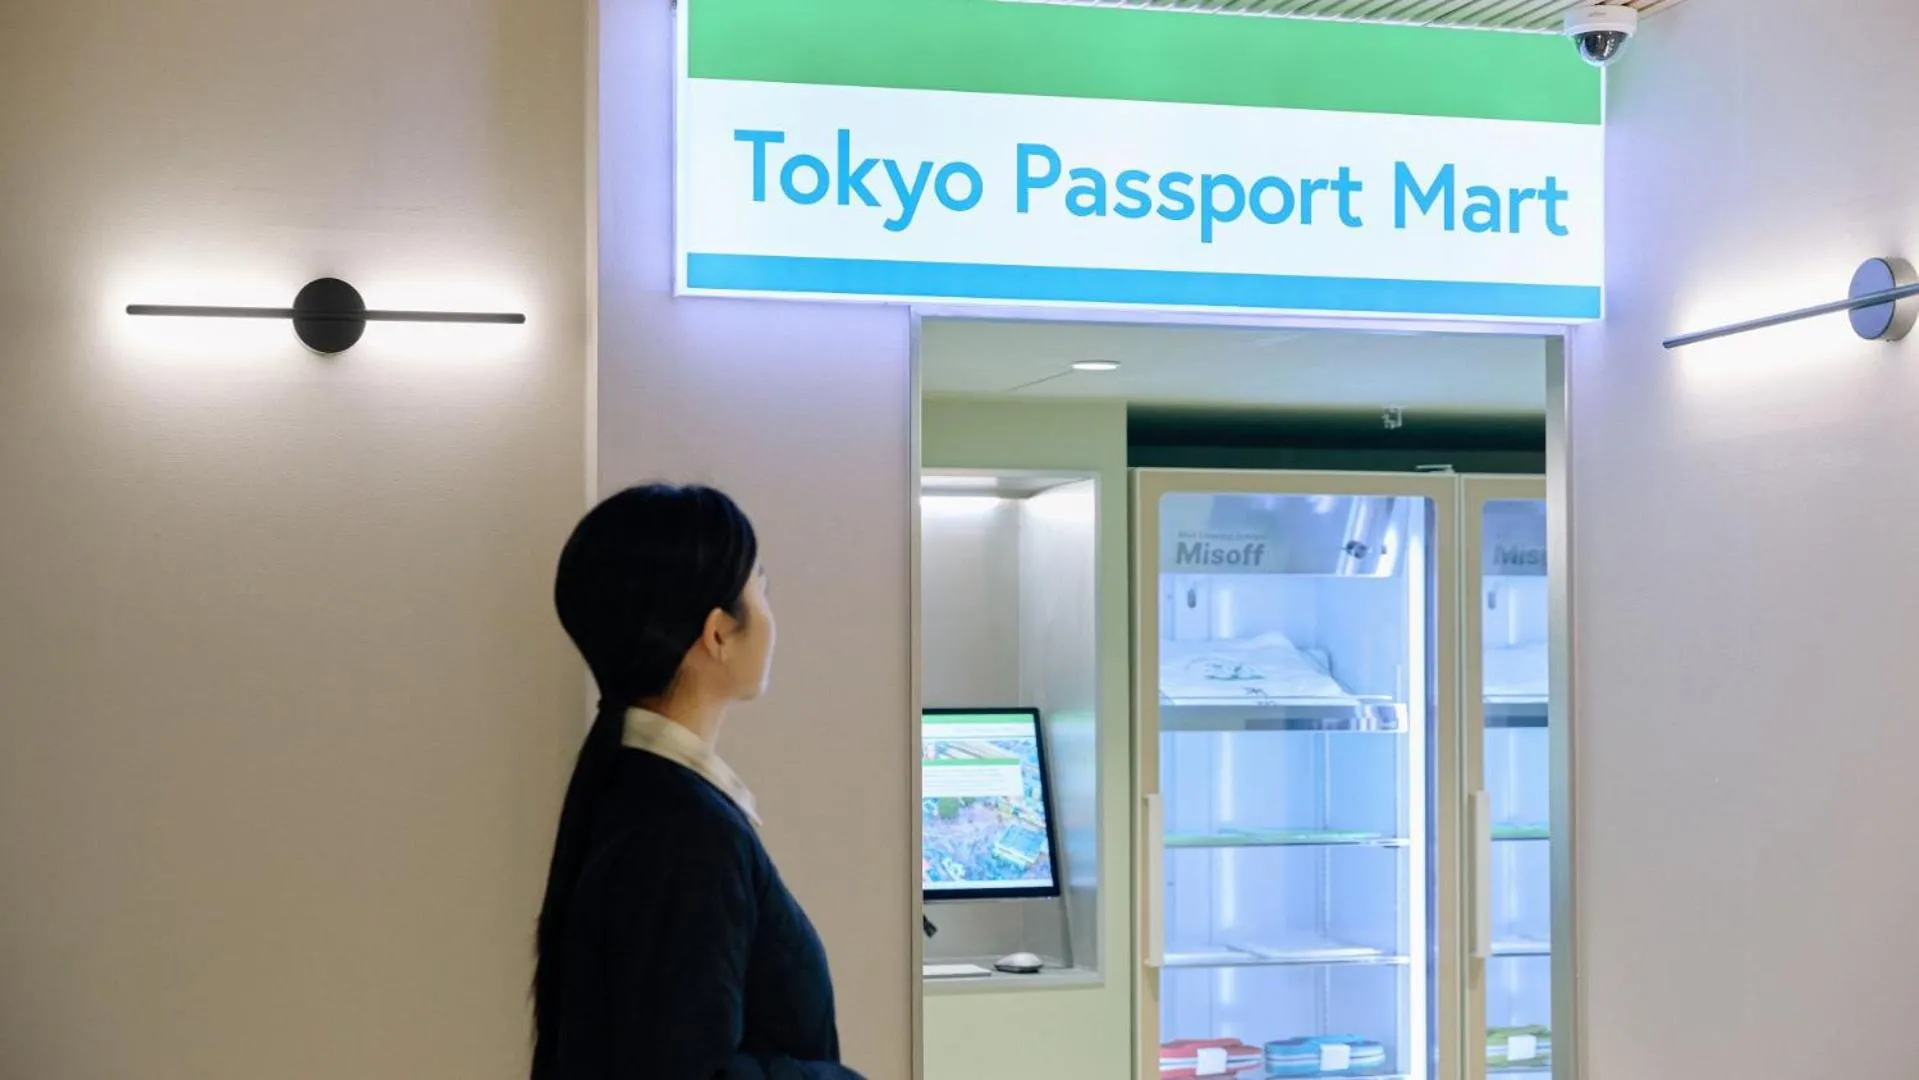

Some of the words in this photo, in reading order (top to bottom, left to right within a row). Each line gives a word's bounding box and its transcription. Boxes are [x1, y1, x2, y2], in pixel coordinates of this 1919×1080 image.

[734, 129, 983, 232] Tokyo
[1017, 143, 1362, 243] Passport
[1395, 161, 1568, 236] Mart
[1176, 541, 1265, 566] Misoff
